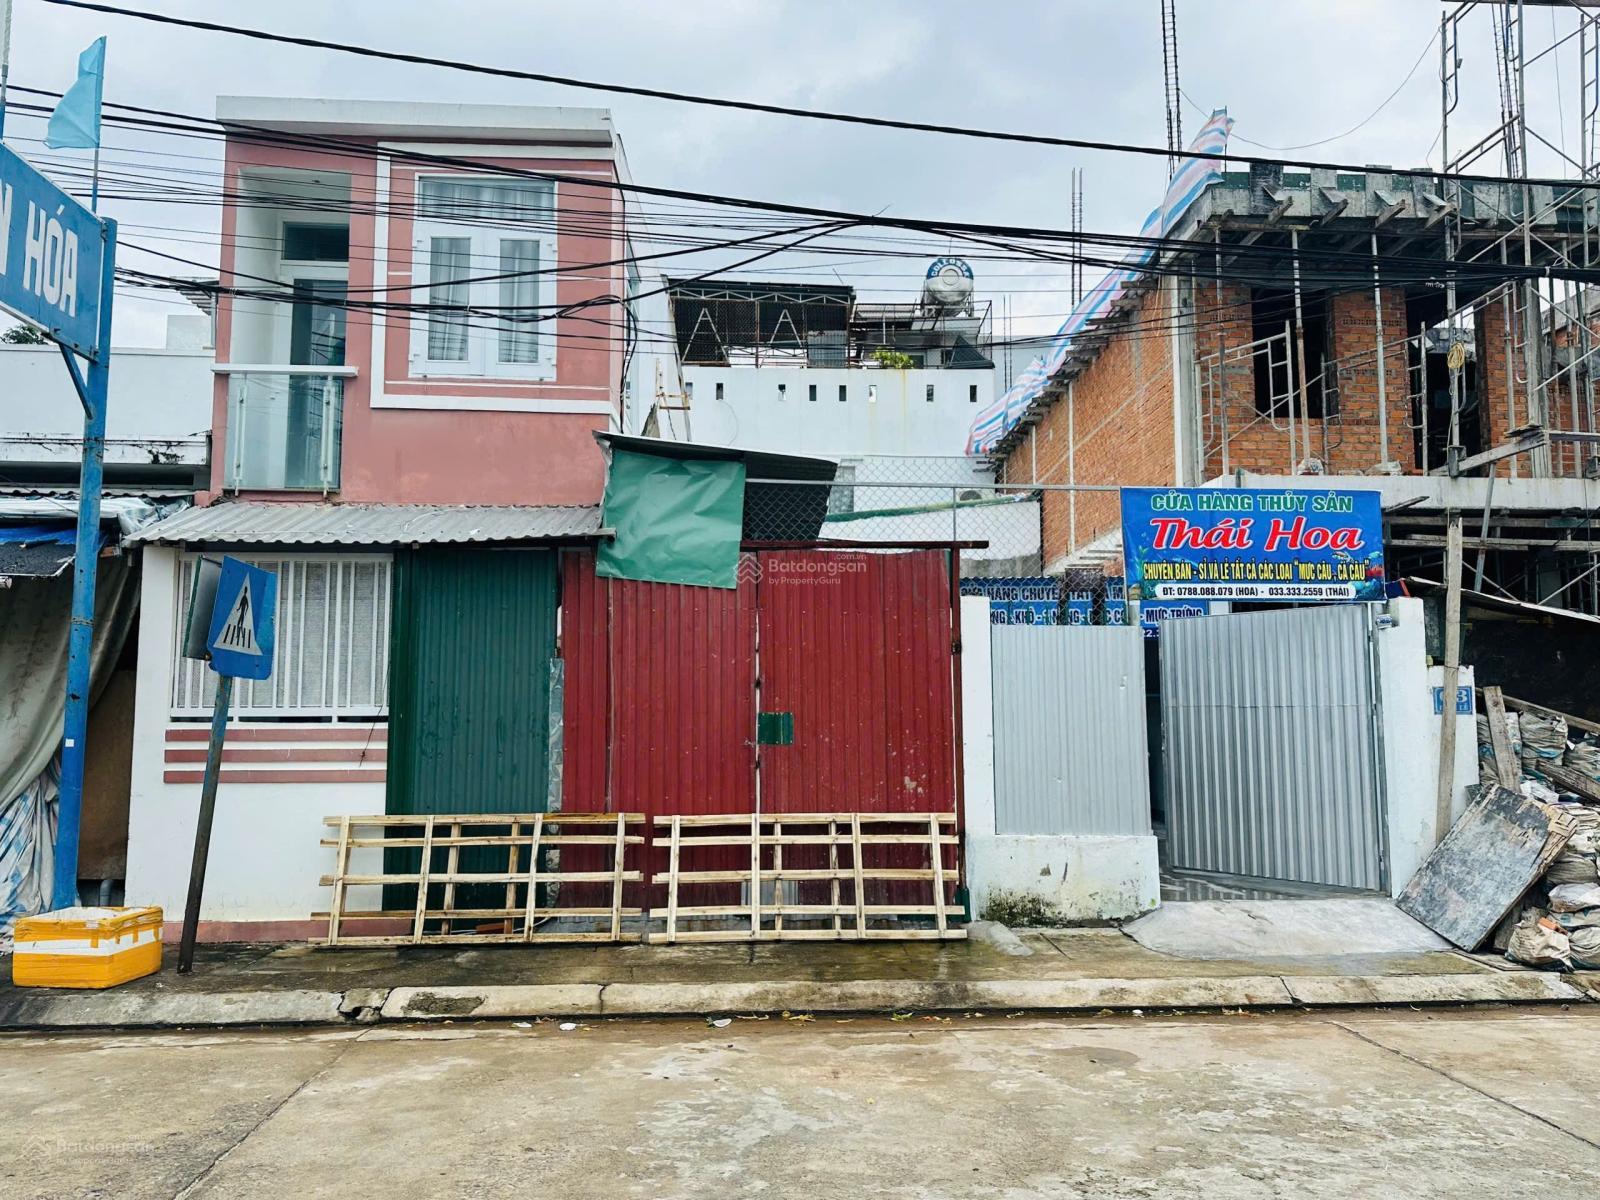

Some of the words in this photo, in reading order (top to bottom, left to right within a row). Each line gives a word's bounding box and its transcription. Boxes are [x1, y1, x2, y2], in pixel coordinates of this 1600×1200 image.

[23, 204, 78, 318] HÓA
[1151, 490, 1193, 511] CỬA
[1197, 492, 1253, 511] HÀNG
[1257, 491, 1307, 512] THỦY
[1312, 491, 1353, 513] SẢN
[1150, 517, 1254, 550] Thái
[1264, 515, 1365, 552] Hoa
[1143, 560, 1173, 580] CHUYÊN
[1162, 587, 1175, 596] ĐT:
[1177, 587, 1233, 596] 0788.088.079
[1235, 587, 1258, 597] (HOA)
[1268, 587, 1323, 597] 033.333.2559
[1325, 585, 1350, 597] (THÁI)
